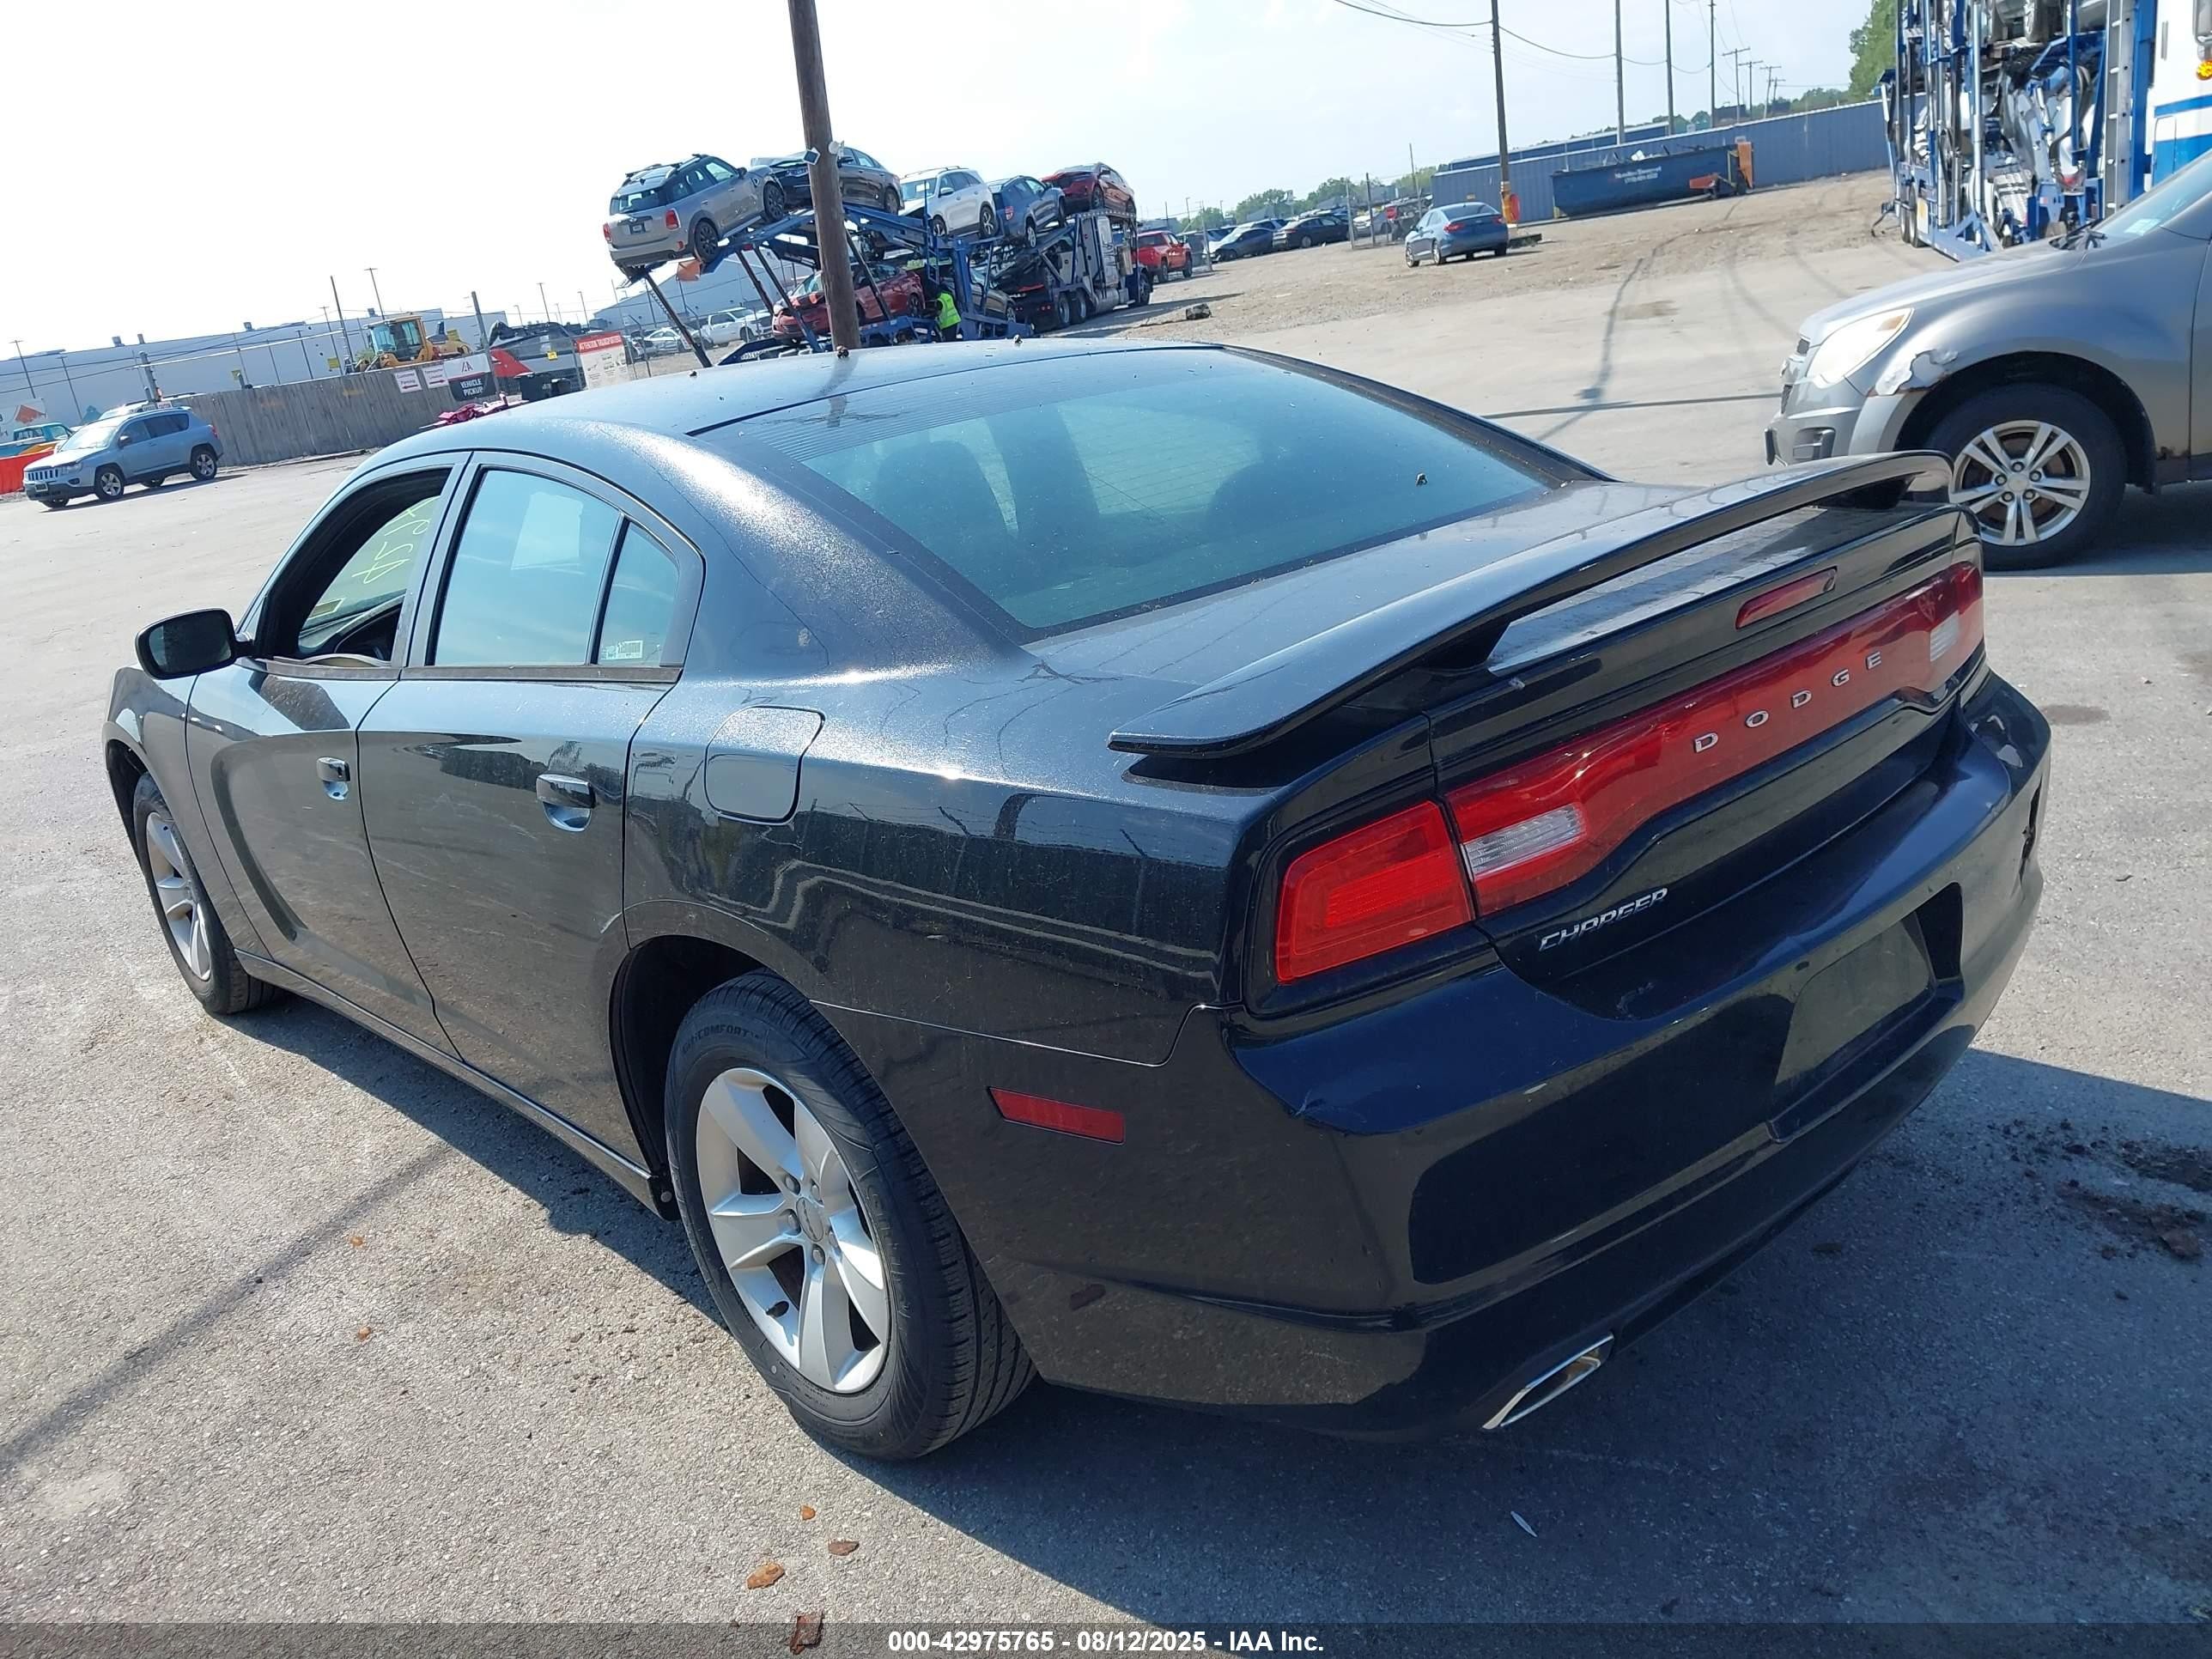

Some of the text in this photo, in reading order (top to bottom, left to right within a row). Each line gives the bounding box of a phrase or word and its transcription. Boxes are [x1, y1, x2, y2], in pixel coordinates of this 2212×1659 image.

[459, 378, 483, 389] VEHICLE
[463, 386, 483, 397] PICKUP
[1693, 651, 1882, 753] DODGE
[1539, 887, 1668, 952] CHARGER
